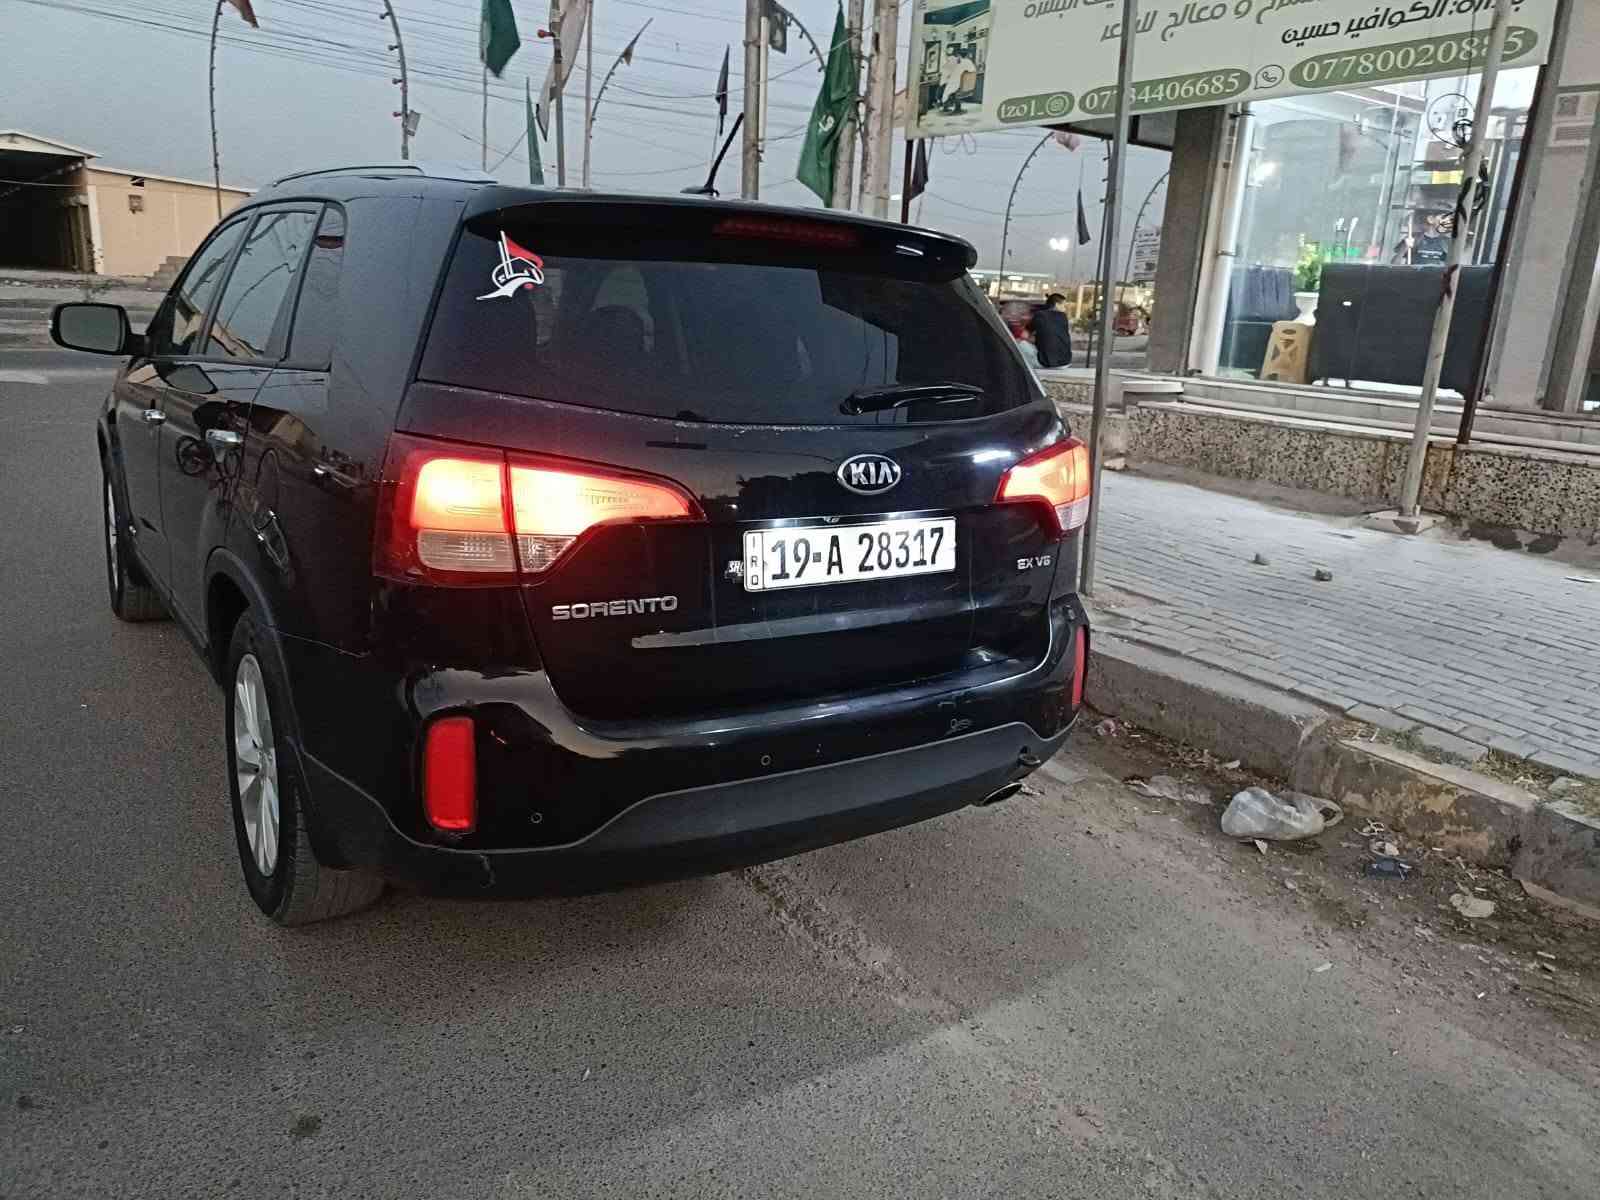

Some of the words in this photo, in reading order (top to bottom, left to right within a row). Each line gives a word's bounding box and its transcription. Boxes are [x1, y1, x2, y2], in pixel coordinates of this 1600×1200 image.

[1161, 3, 1228, 42] معالج
[1233, 0, 1253, 19] و
[1281, 21, 1340, 47] حسين
[849, 461, 894, 485] KIA
[858, 527, 944, 573] 28317
[1017, 558, 1034, 570] EX
[551, 595, 678, 621] SORENTO
